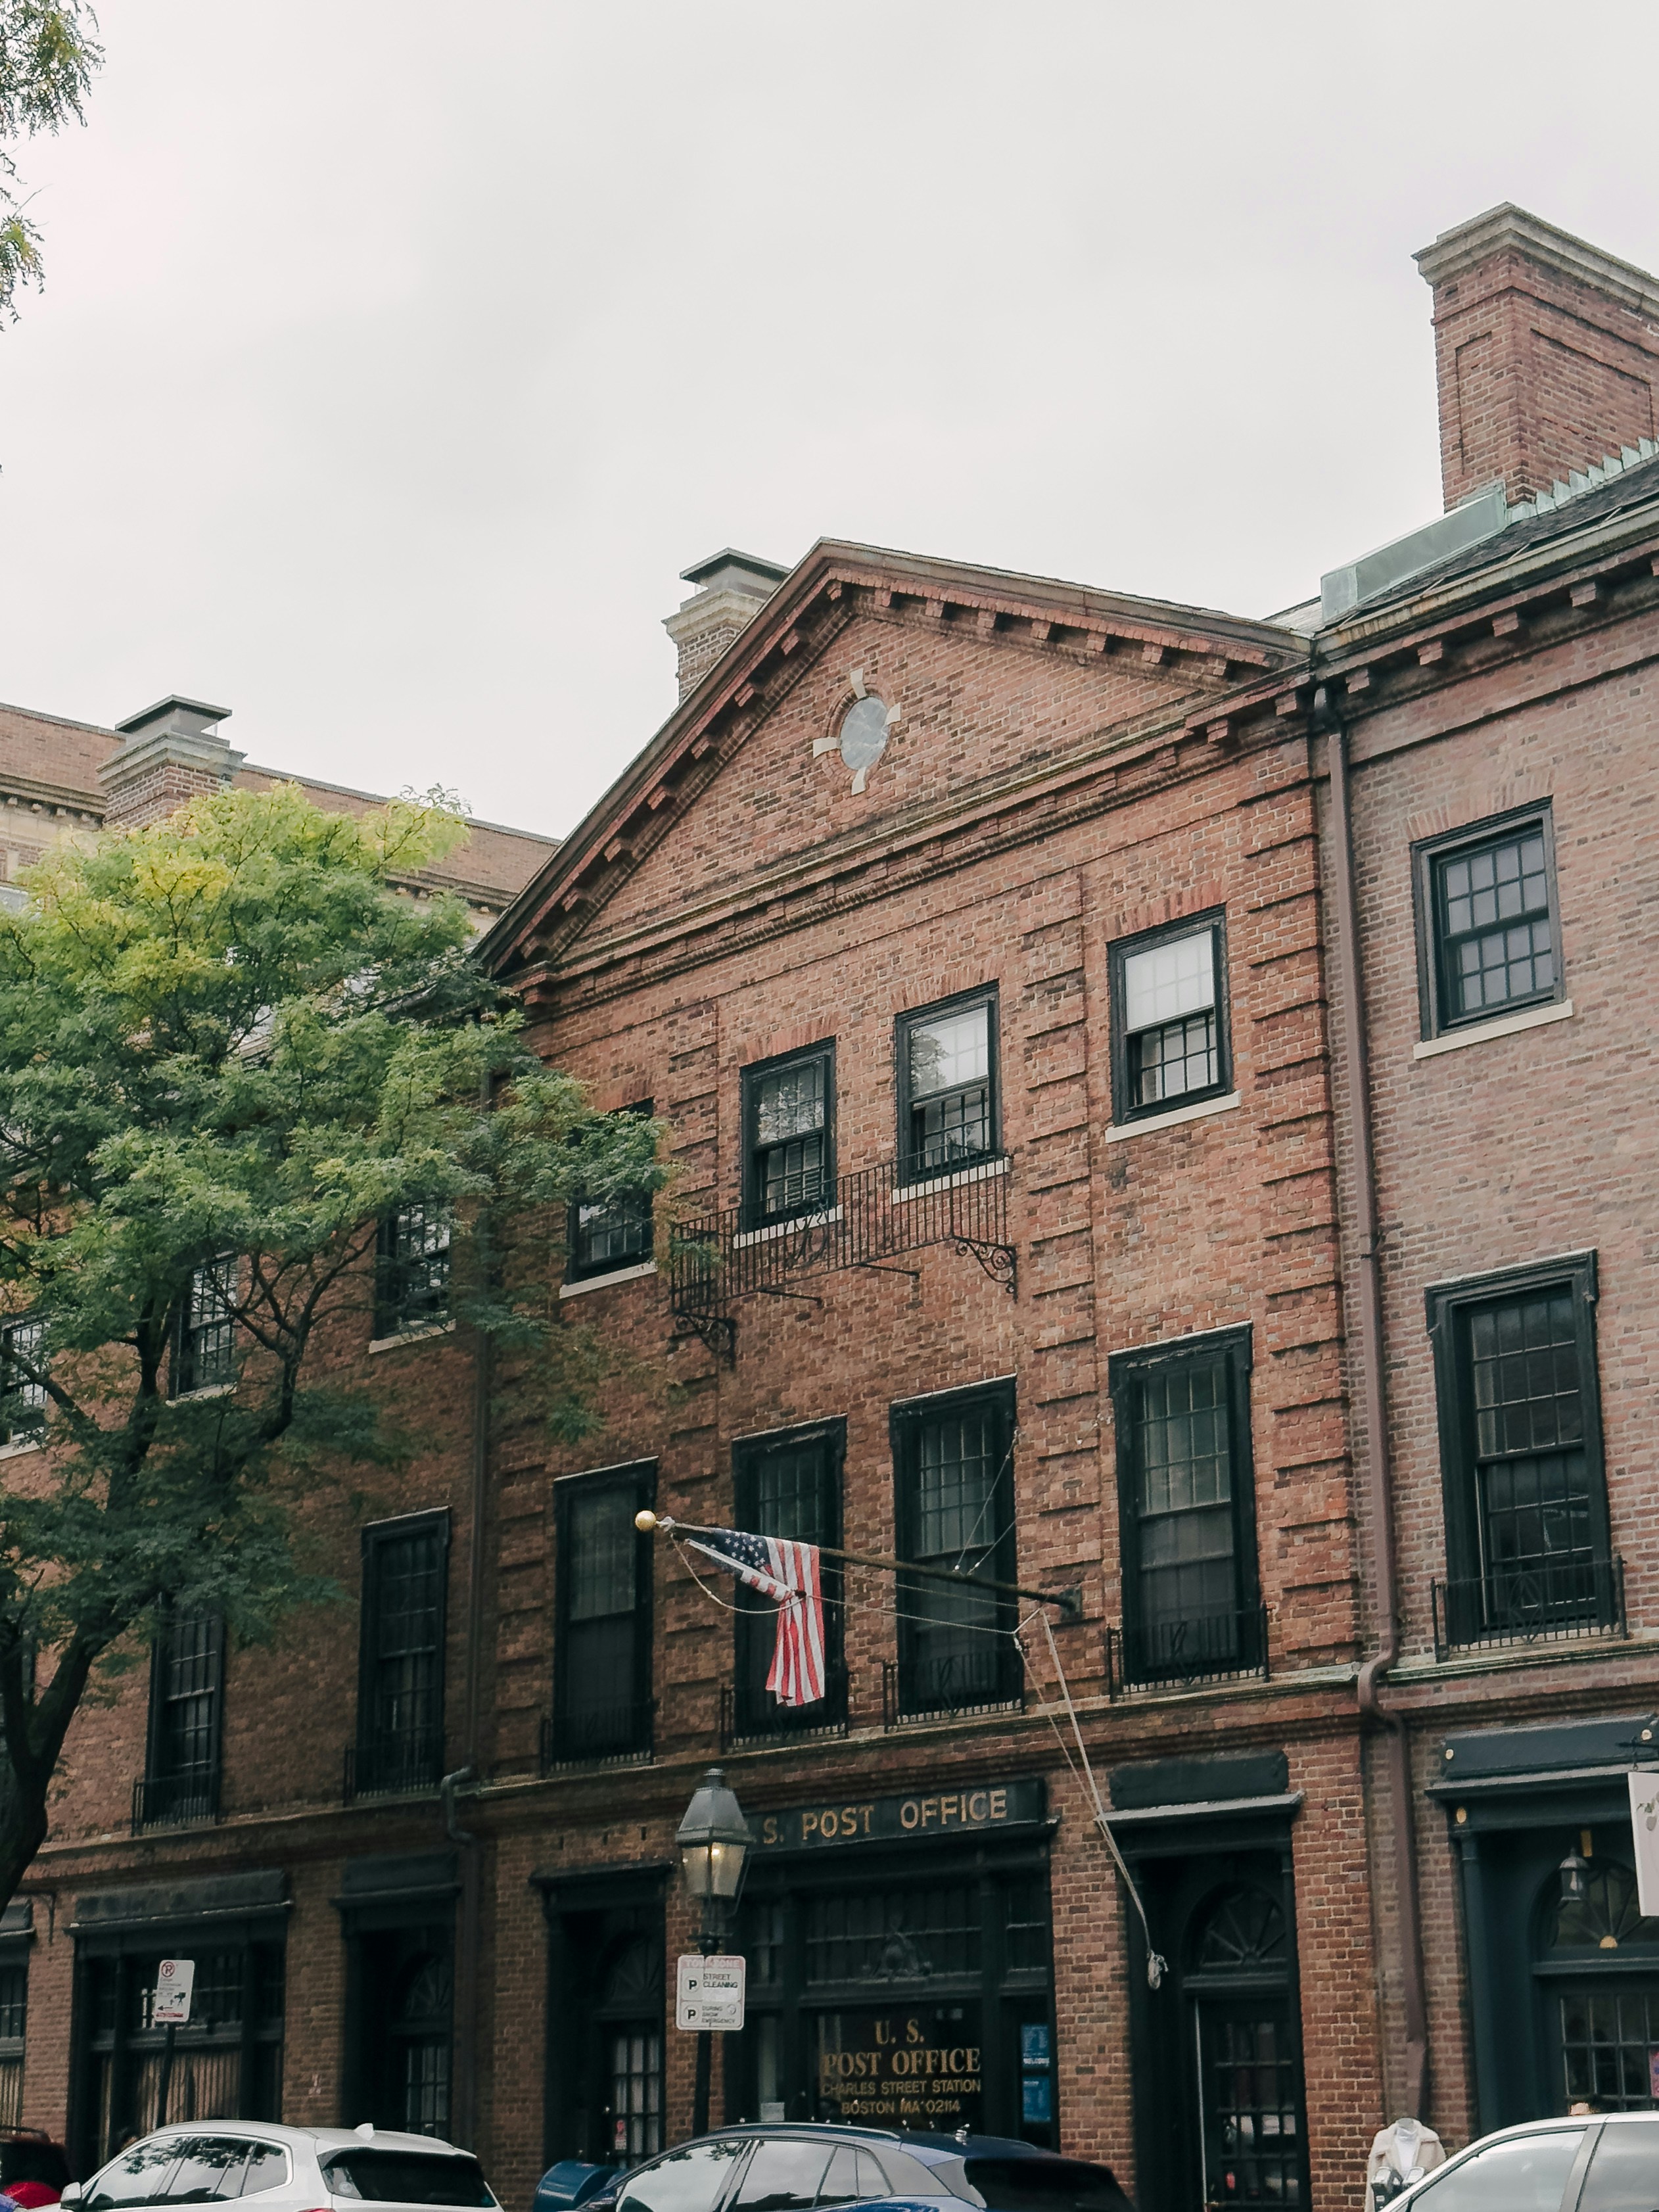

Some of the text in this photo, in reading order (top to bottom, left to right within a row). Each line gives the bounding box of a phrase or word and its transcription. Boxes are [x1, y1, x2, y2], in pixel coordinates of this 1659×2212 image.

[802, 1805, 874, 1840] POST
[900, 1789, 1008, 1829] OFFICE
[823, 2048, 981, 2077] POST OFFICE
[822, 2079, 981, 2096] CHARLES STREET STATION
[841, 2101, 895, 2115] BOSTON
[925, 2099, 961, 2113] 02114
